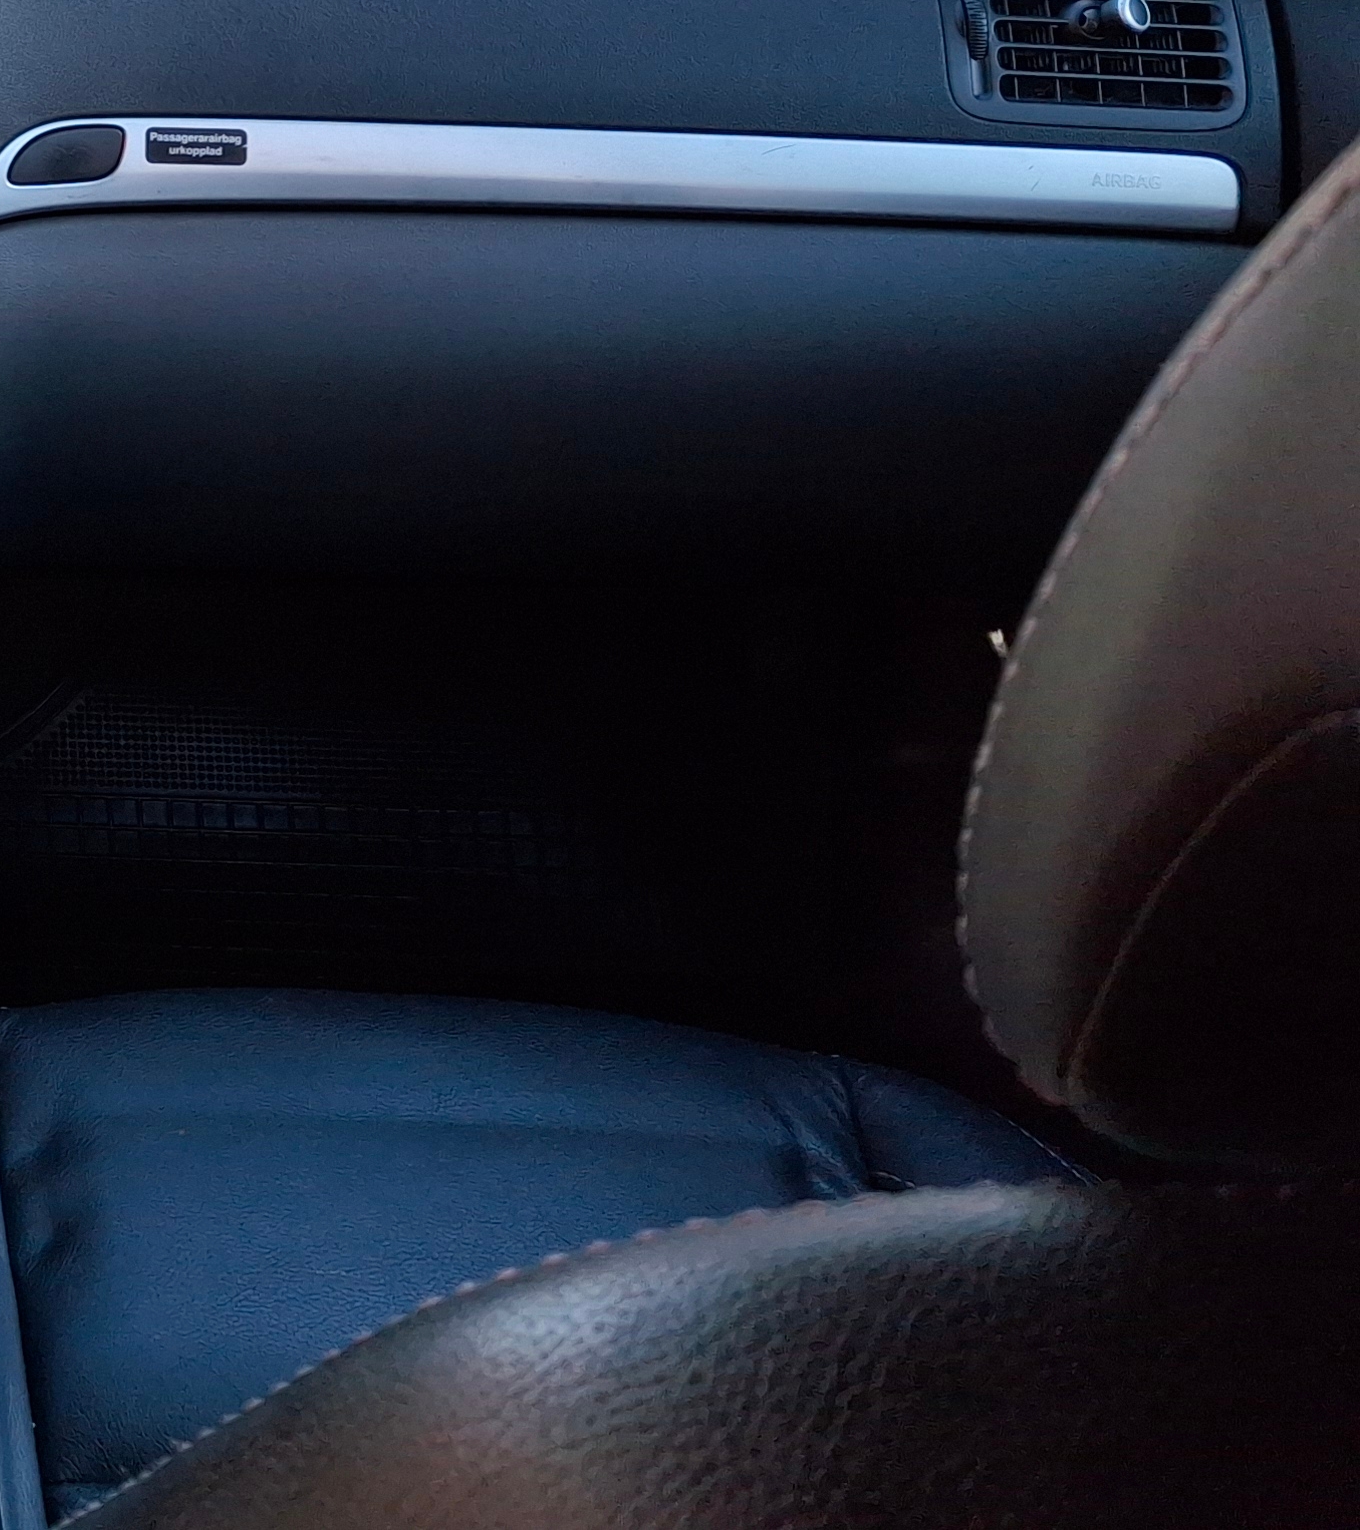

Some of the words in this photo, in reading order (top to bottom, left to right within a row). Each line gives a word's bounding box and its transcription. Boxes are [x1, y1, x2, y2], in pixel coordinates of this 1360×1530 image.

[149, 131, 242, 146] Passagerarairbag
[168, 146, 223, 157] urkopplad
[1091, 172, 1162, 190] AIRBAG
